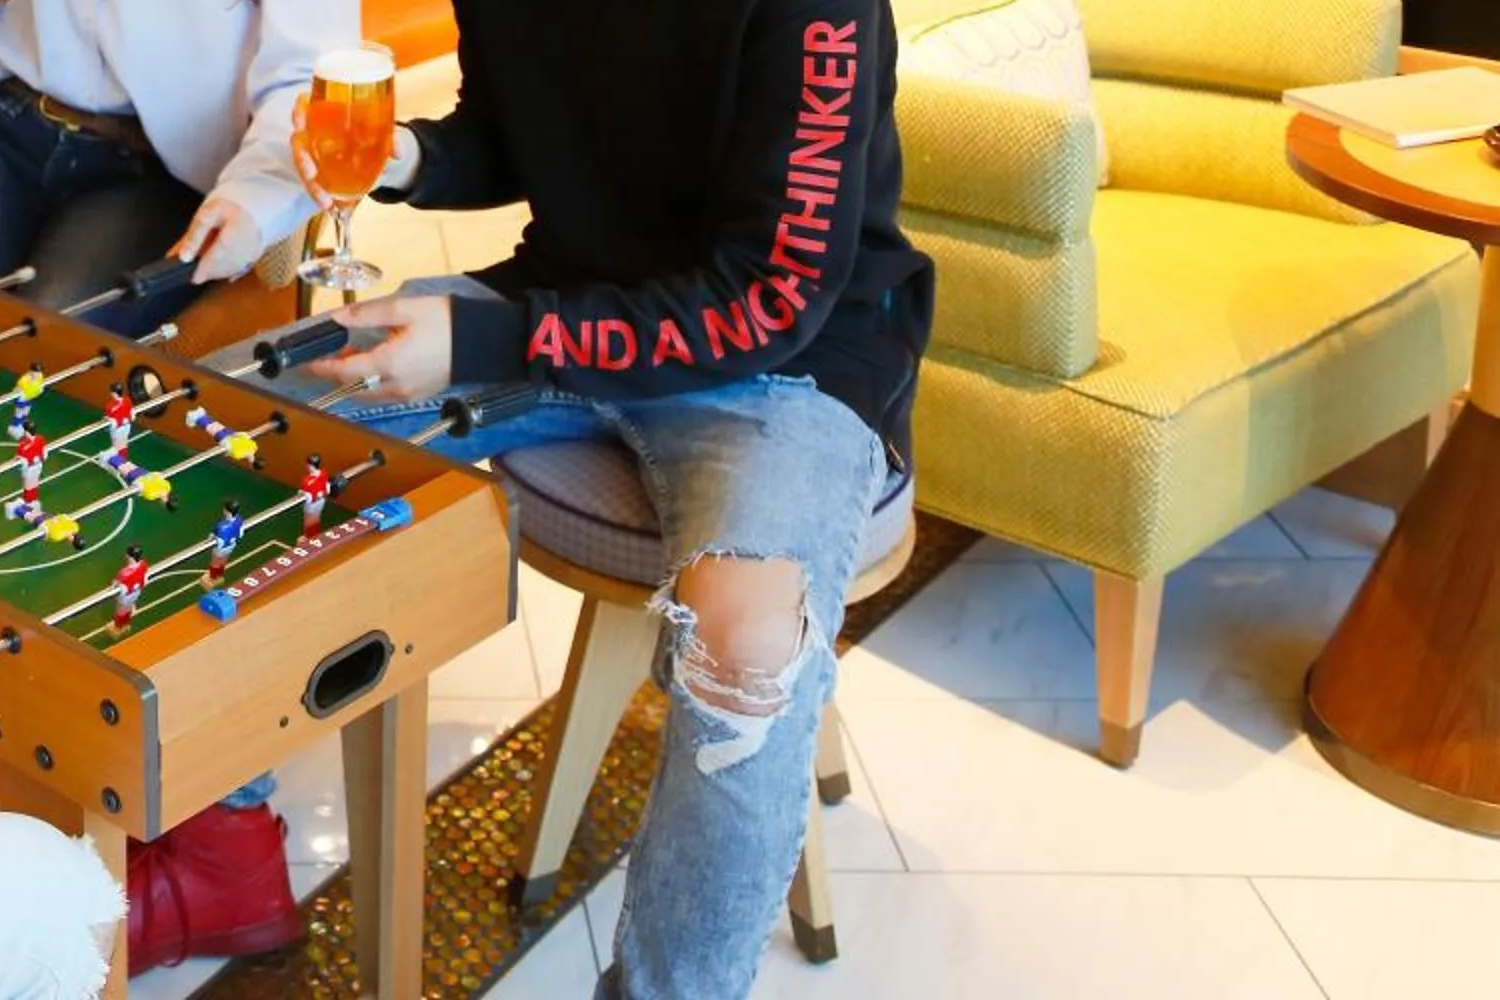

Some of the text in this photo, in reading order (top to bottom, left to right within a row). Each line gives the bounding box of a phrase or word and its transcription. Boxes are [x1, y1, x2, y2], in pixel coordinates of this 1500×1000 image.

[527, 312, 638, 371] AND
[651, 318, 695, 366] A
[309, 538, 323, 548] 4
[261, 566, 277, 577] 7
